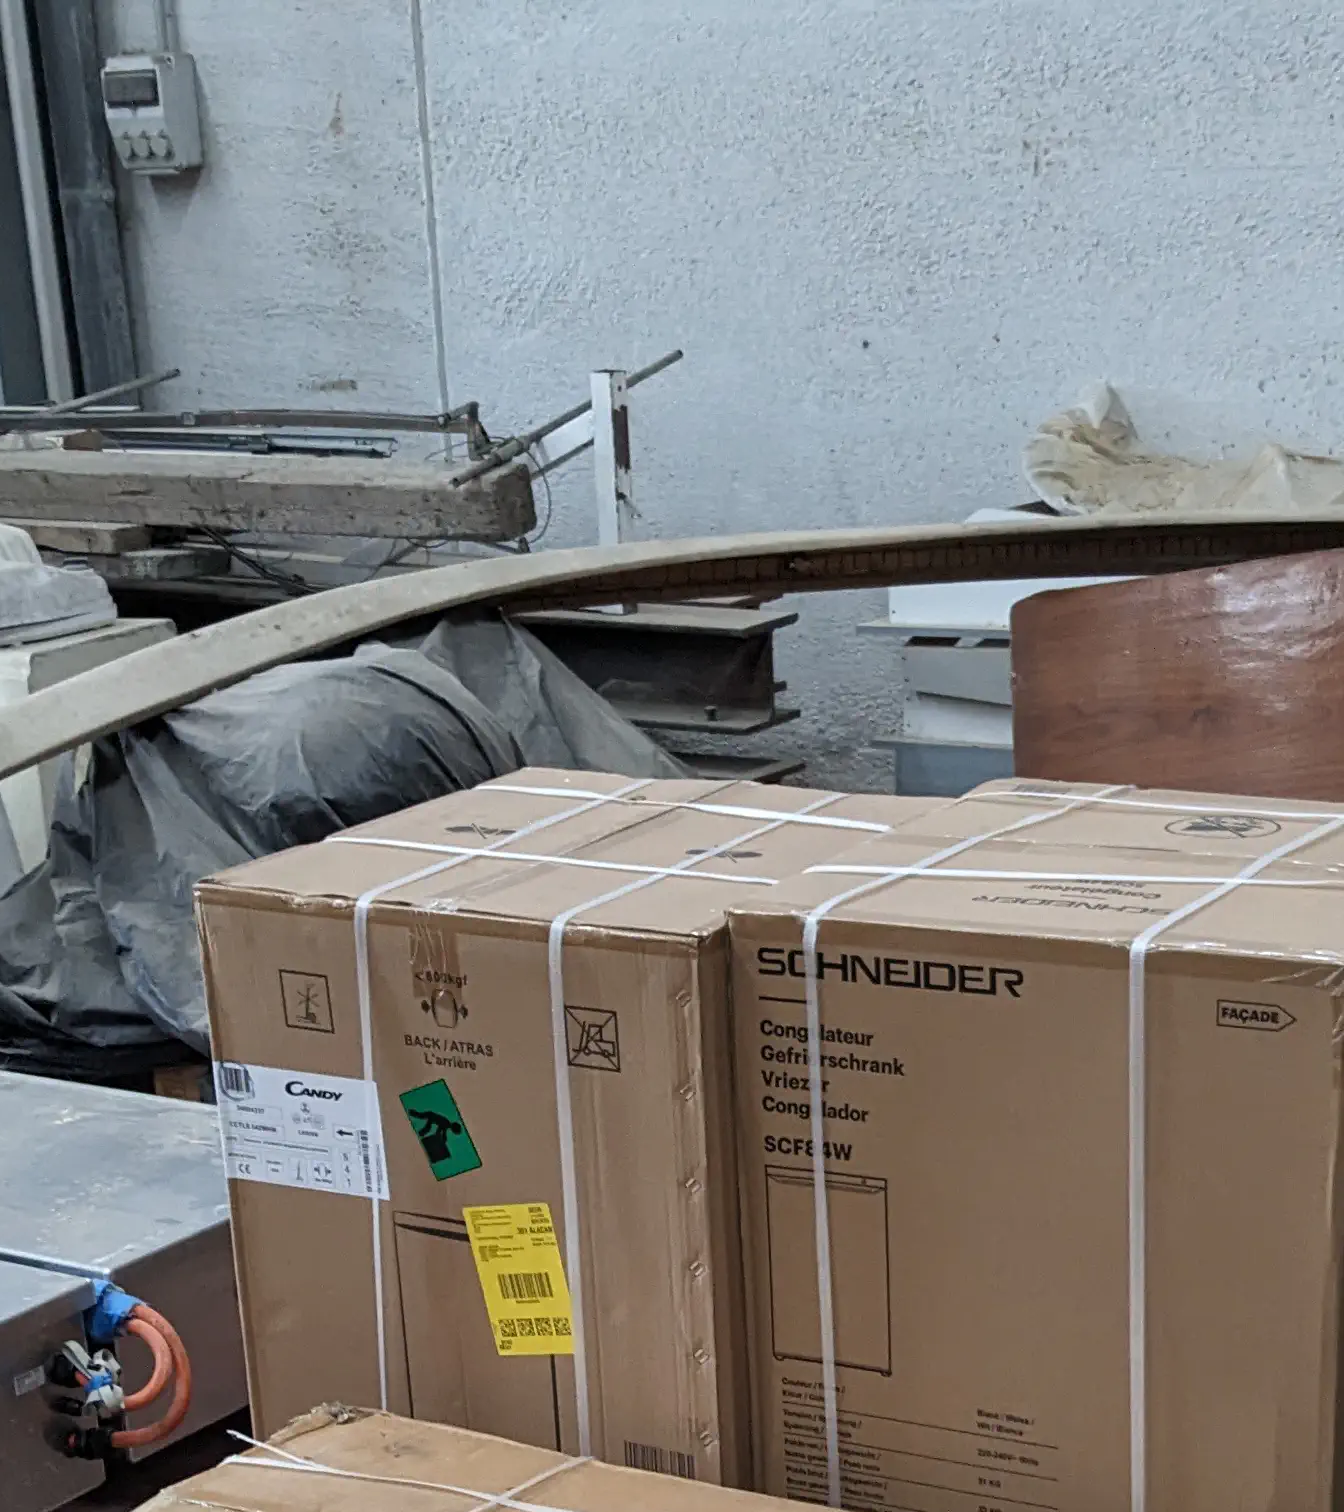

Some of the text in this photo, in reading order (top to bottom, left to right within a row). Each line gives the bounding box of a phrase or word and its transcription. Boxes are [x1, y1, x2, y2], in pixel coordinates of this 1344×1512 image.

[757, 947, 1024, 998] SCHNEIDER
[1221, 1007, 1280, 1024] FAÇADE
[403, 1034, 441, 1050] BACK
[450, 1040, 494, 1057] ATRAS
[760, 1019, 875, 1047] Conglateur
[760, 1045, 905, 1076] Gefrirschrank
[761, 1070, 830, 1093] Vriezr
[762, 1095, 869, 1122] Conglador
